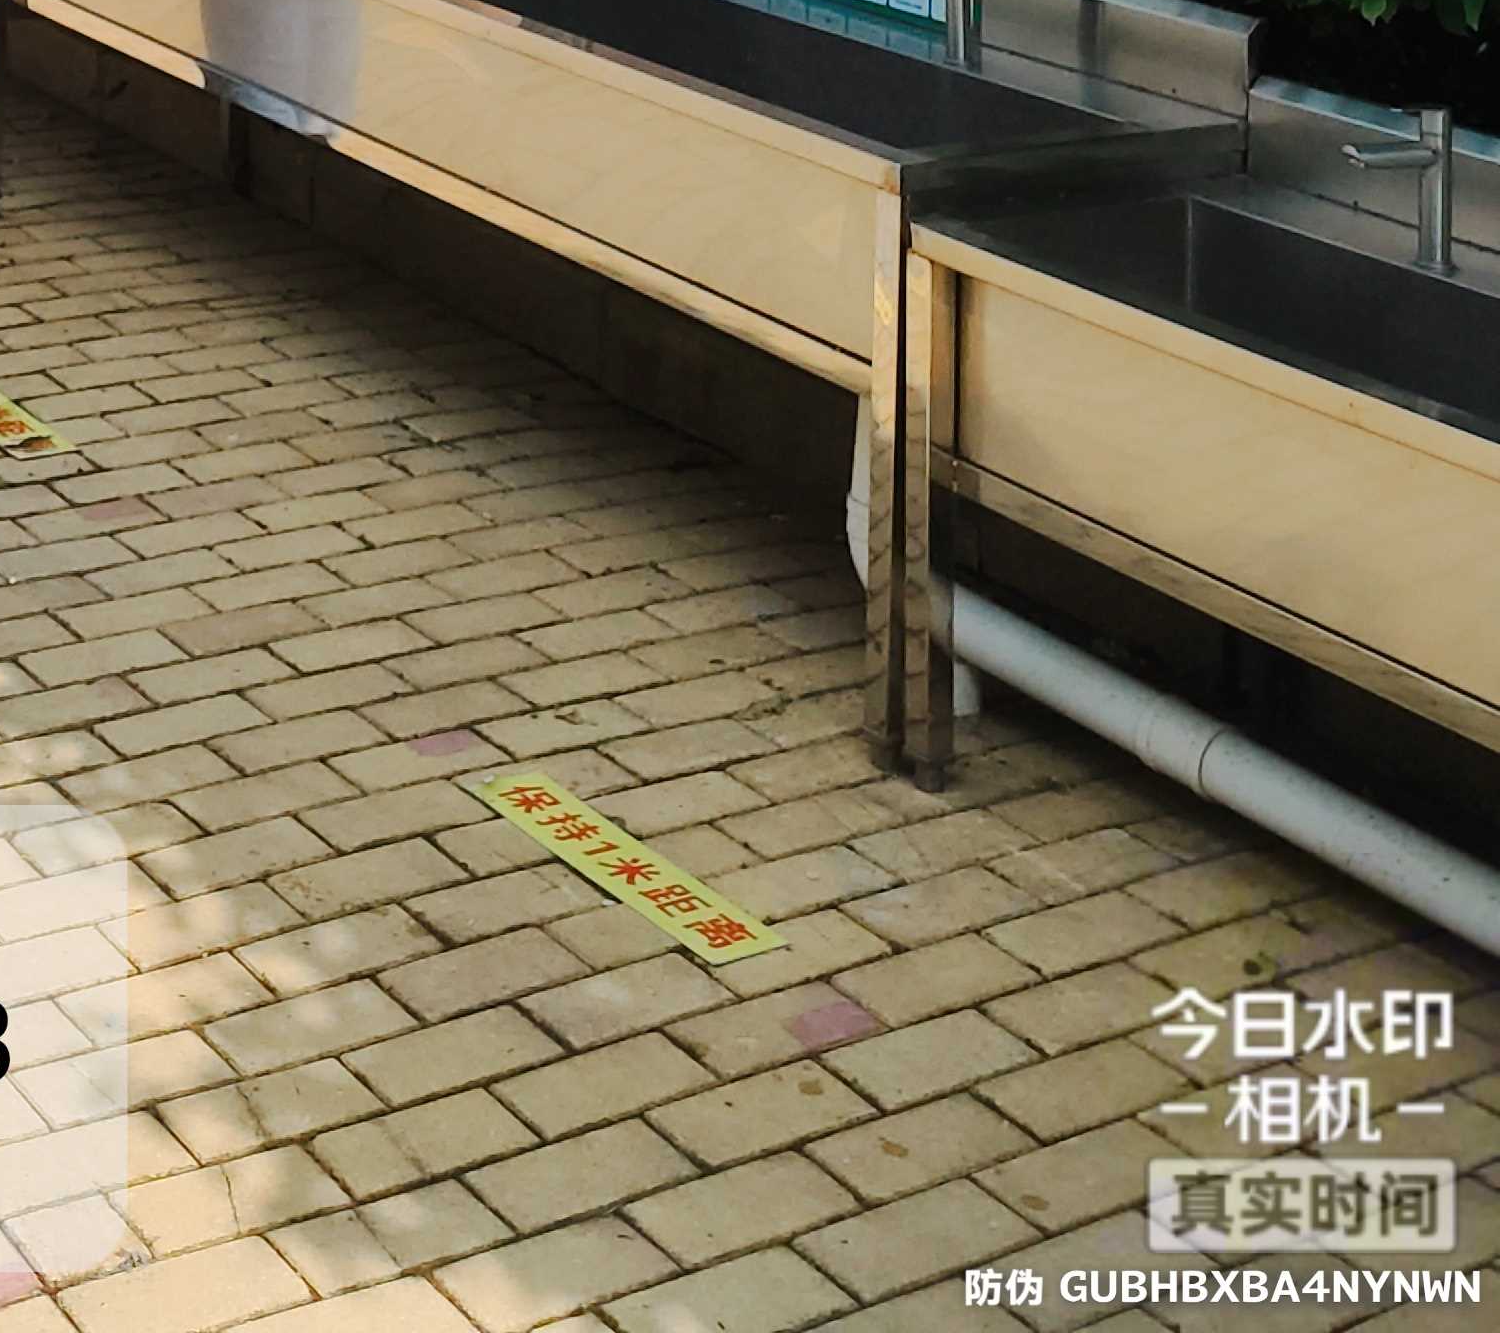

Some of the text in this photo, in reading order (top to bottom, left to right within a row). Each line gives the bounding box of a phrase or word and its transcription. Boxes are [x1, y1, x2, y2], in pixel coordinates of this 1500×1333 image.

[497, 785, 759, 950] 保持1米距离
